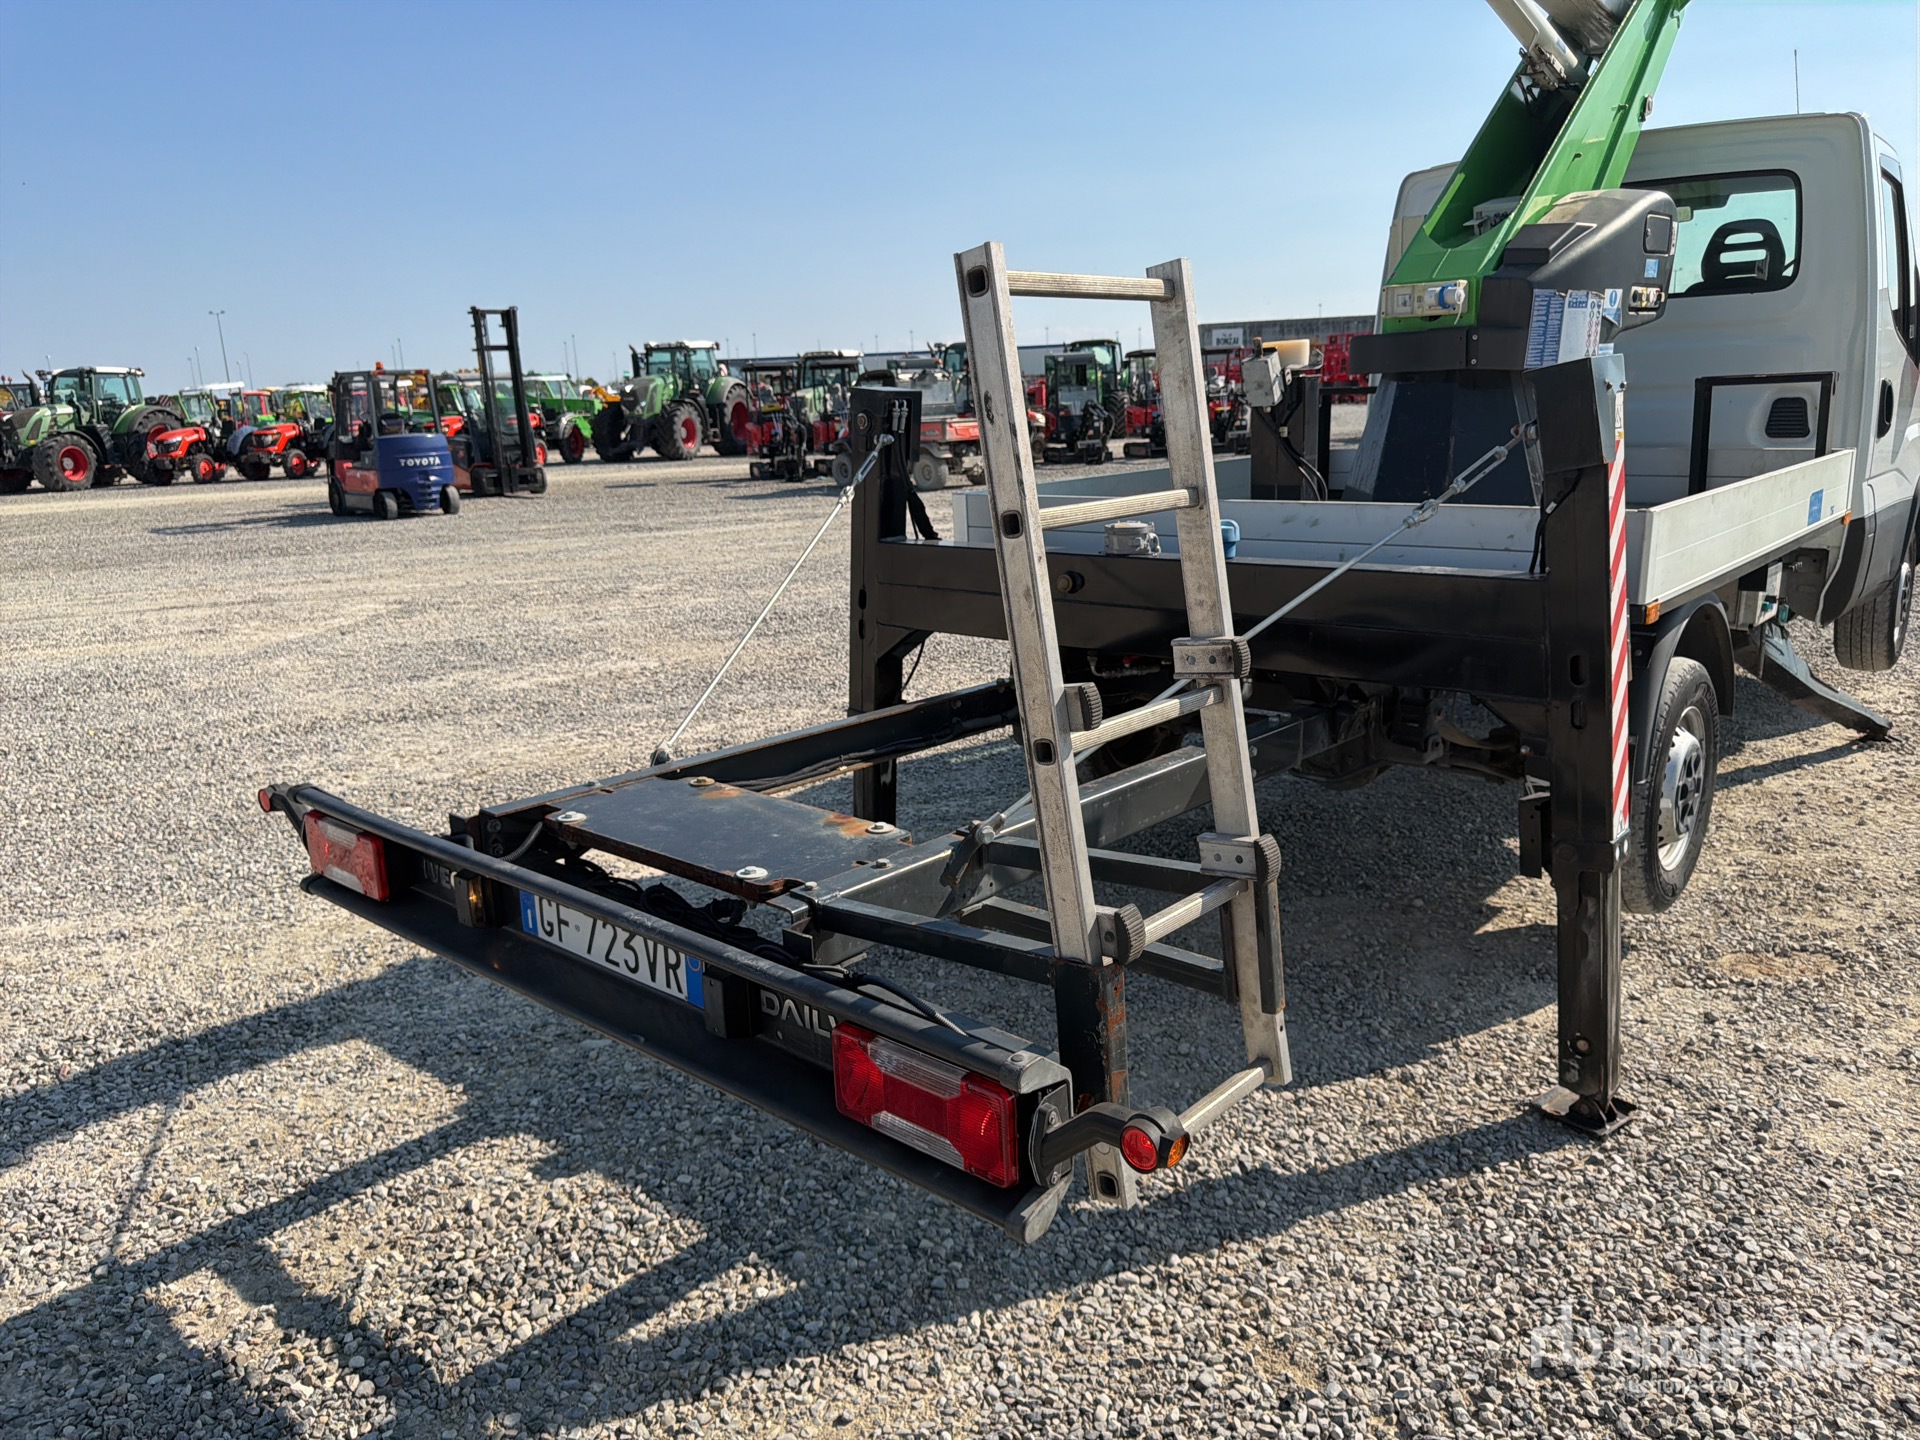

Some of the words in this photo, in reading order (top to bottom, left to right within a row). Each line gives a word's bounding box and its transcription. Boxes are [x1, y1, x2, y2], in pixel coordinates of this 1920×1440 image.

[399, 456, 441, 467] TOYOTA
[539, 896, 570, 943] GF
[587, 918, 684, 995] 723VR
